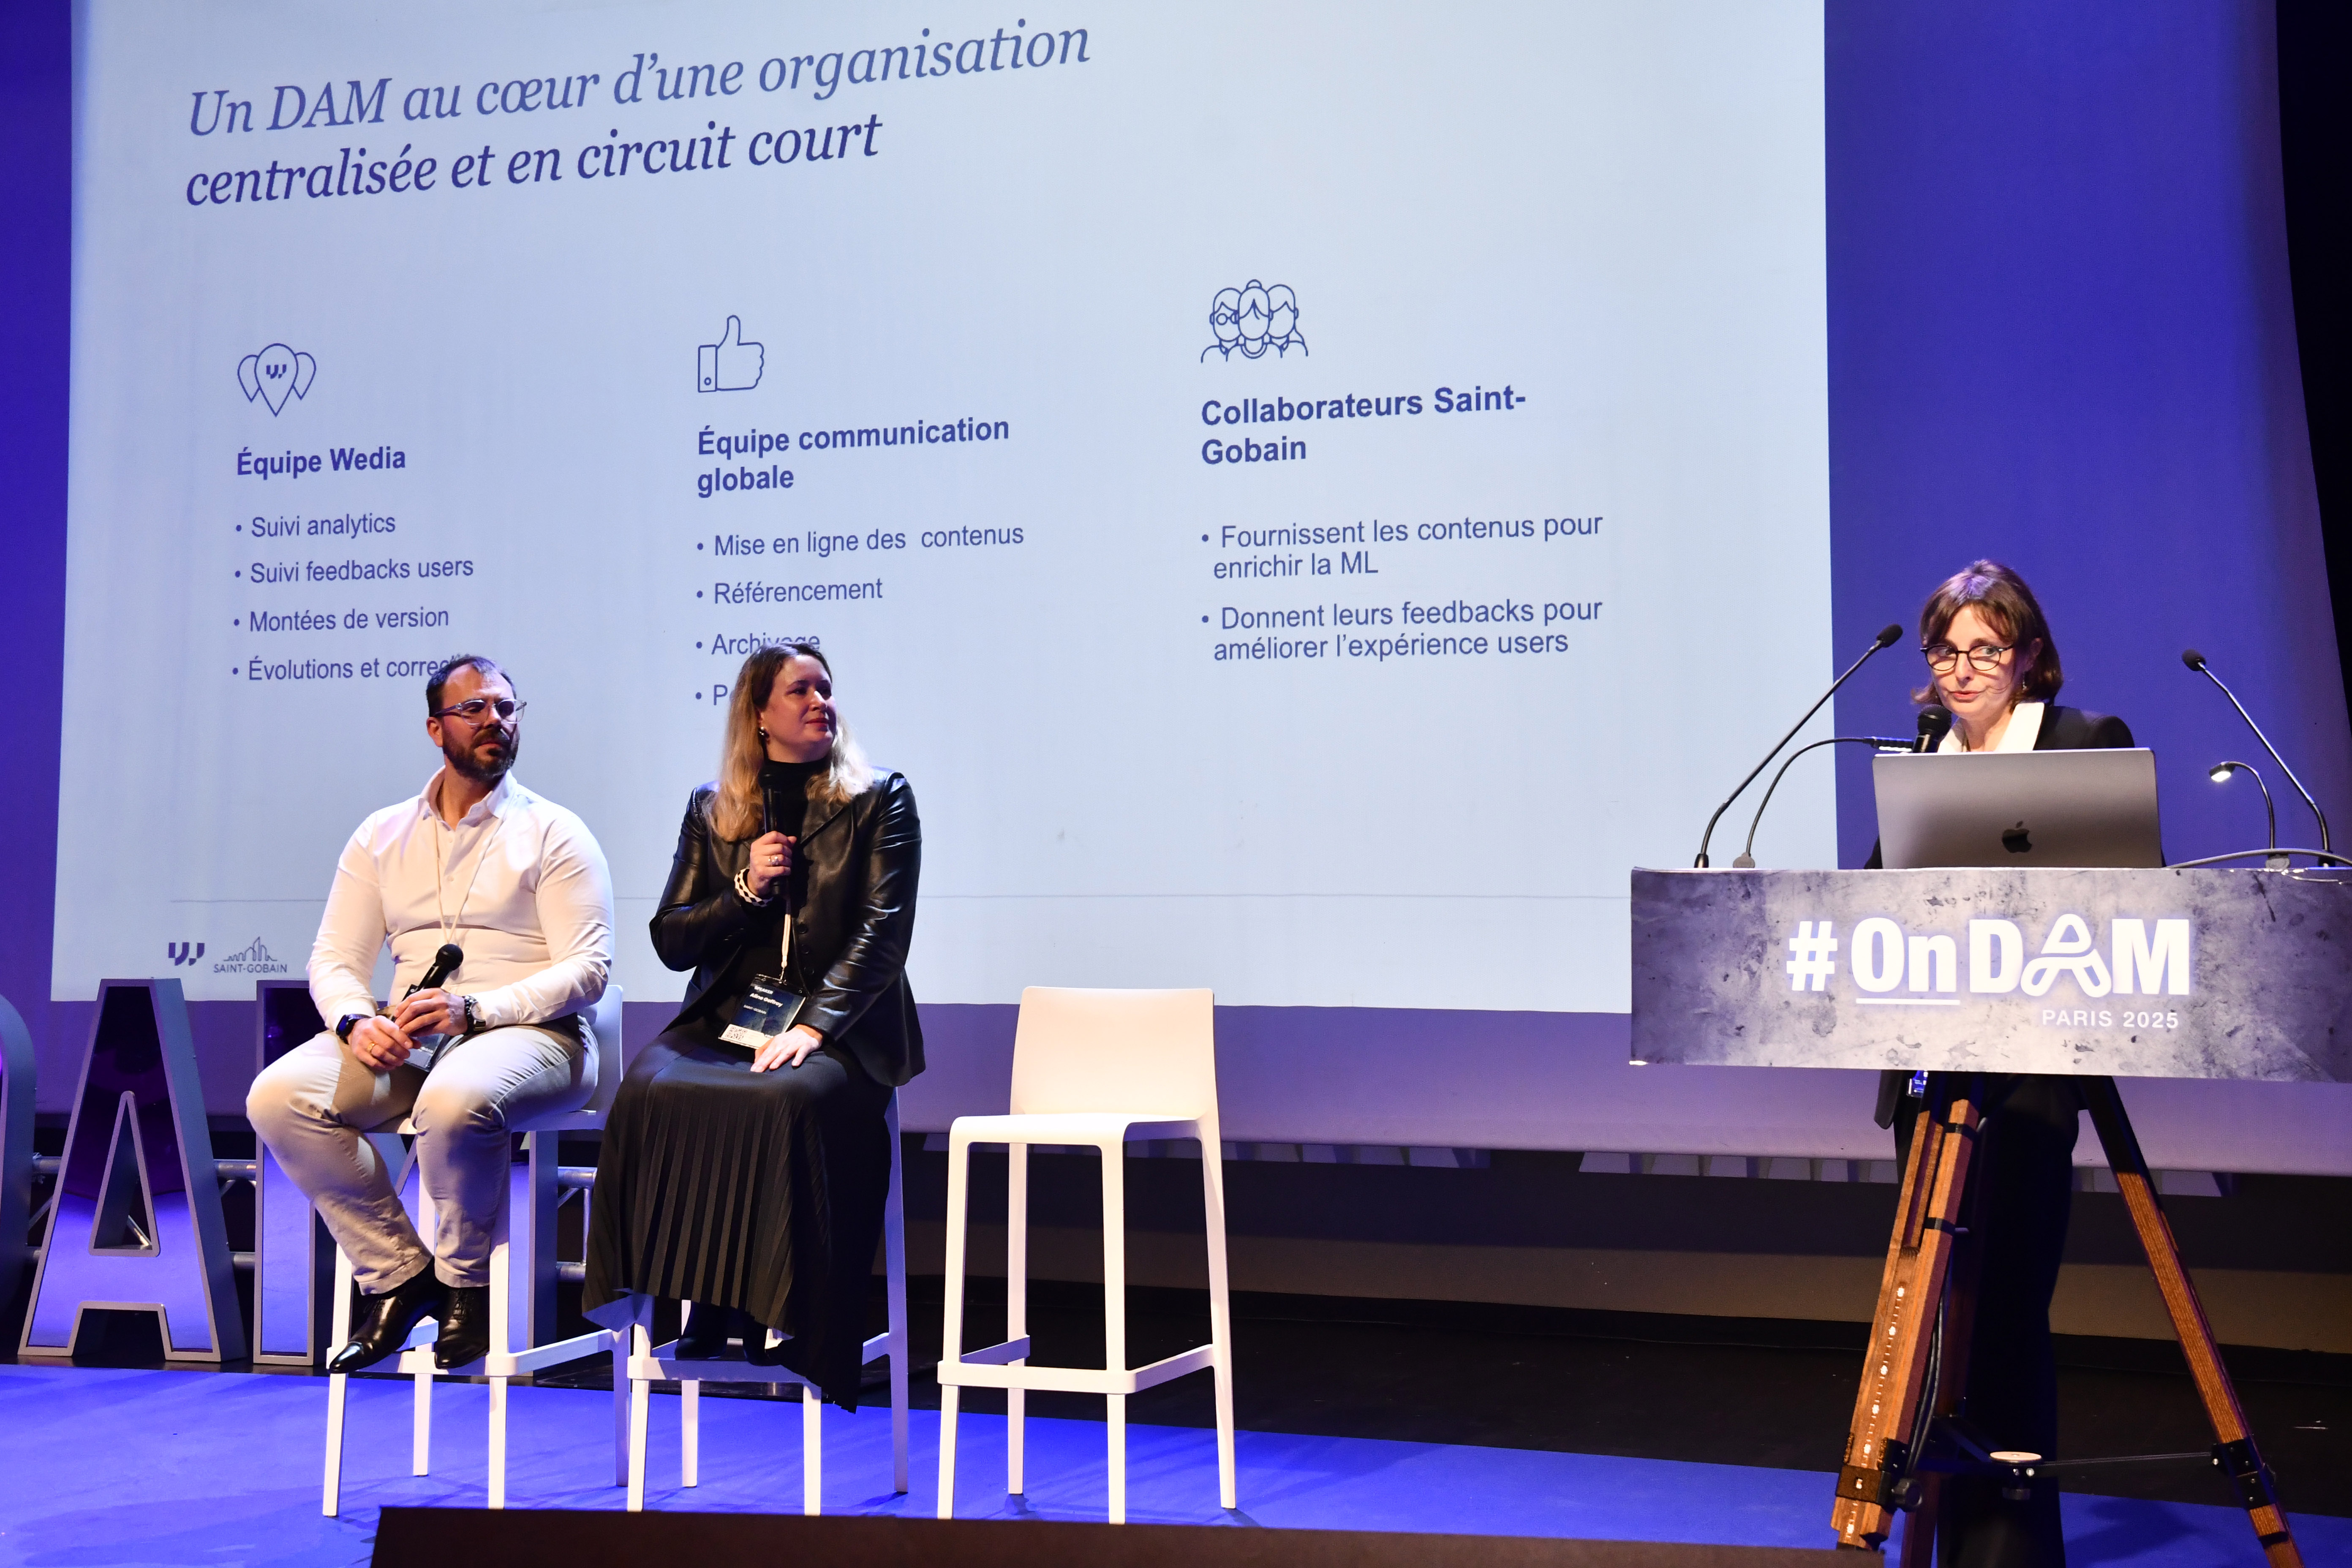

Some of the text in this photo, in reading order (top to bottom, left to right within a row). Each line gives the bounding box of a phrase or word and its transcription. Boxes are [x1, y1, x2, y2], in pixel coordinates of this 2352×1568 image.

[191, 18, 1090, 136] Un DAM au cœur d’une organisation
[186, 114, 883, 206] centralisée et en circuit court
[1201, 385, 1526, 426] Collaborateurs Saint-
[699, 416, 1009, 460] Équipe communication
[1201, 436, 1306, 465] Gobain
[237, 446, 406, 480] Équipe Wedia
[697, 465, 794, 498] globale
[251, 512, 396, 539] Suivi analytics
[1222, 517, 1603, 548] Fournissent les contenus pour
[715, 525, 1024, 558] Mise en ligne des contenus
[250, 558, 474, 583] Suivi feedbacks users
[1214, 551, 1378, 579] enrichir la ML
[715, 578, 883, 604] Référencement
[250, 606, 449, 632] Montées de version
[1222, 599, 1603, 630] Donnent leurs feedbacks pour
[712, 632, 820, 655] Archie
[1214, 632, 1568, 662] améliorer l’expérience users
[249, 655, 353, 681] Évolutions
[360, 658, 380, 678] et
[213, 964, 287, 973] SAINT-GOBAIN
[2042, 1010, 2179, 1029] PARIS 2025
